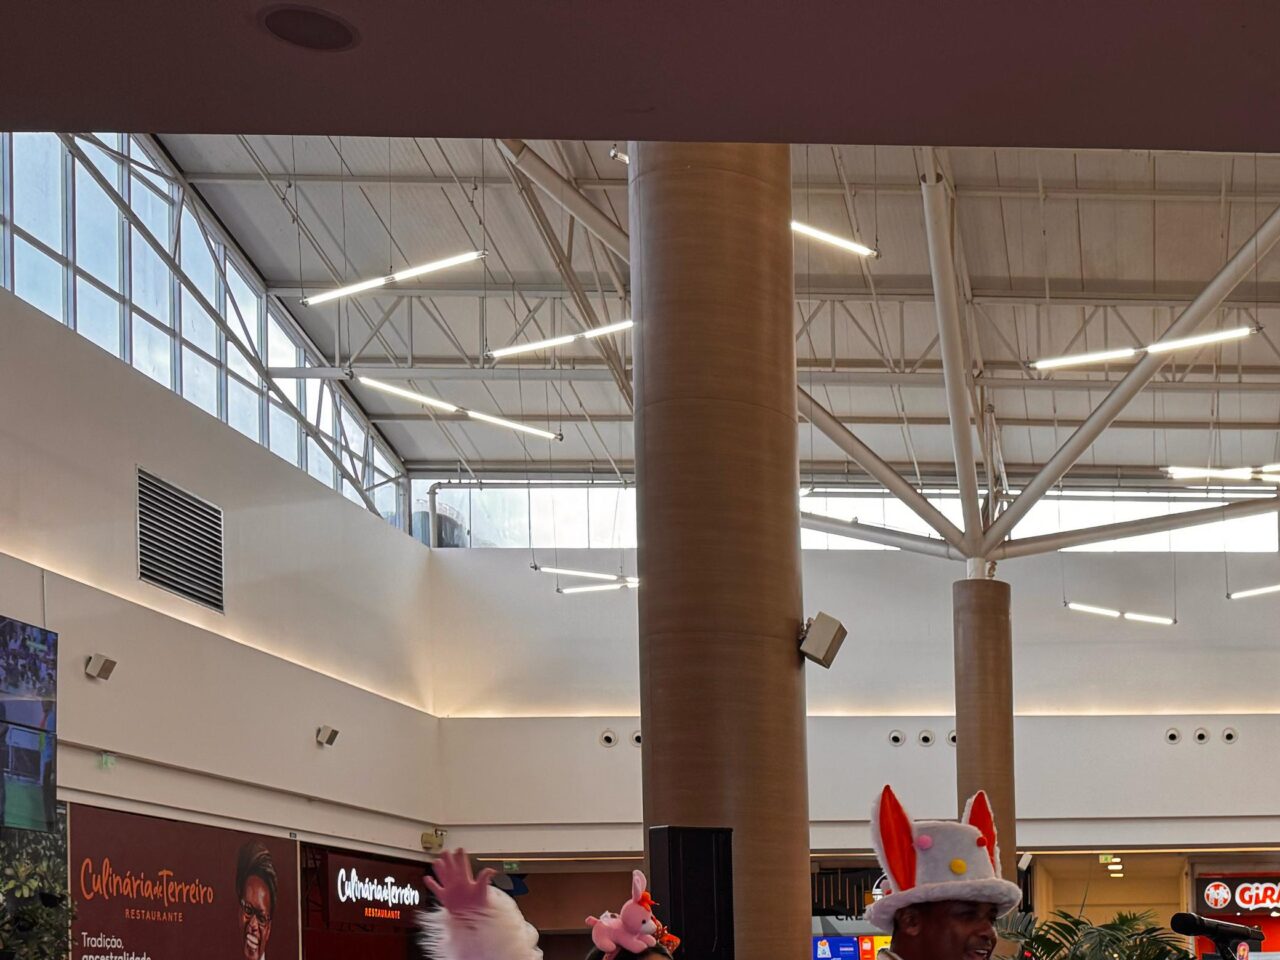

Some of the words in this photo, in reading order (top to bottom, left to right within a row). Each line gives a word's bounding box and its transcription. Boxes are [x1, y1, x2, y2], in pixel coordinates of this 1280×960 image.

[81, 857, 153, 900] Culinária
[158, 869, 214, 907] Terreiro
[337, 868, 384, 902] Culinária
[384, 876, 419, 907] Terreiro
[125, 909, 183, 923] RESTAURANTE
[365, 907, 400, 919] RESTAURANTE
[81, 932, 124, 950] Tradição,
